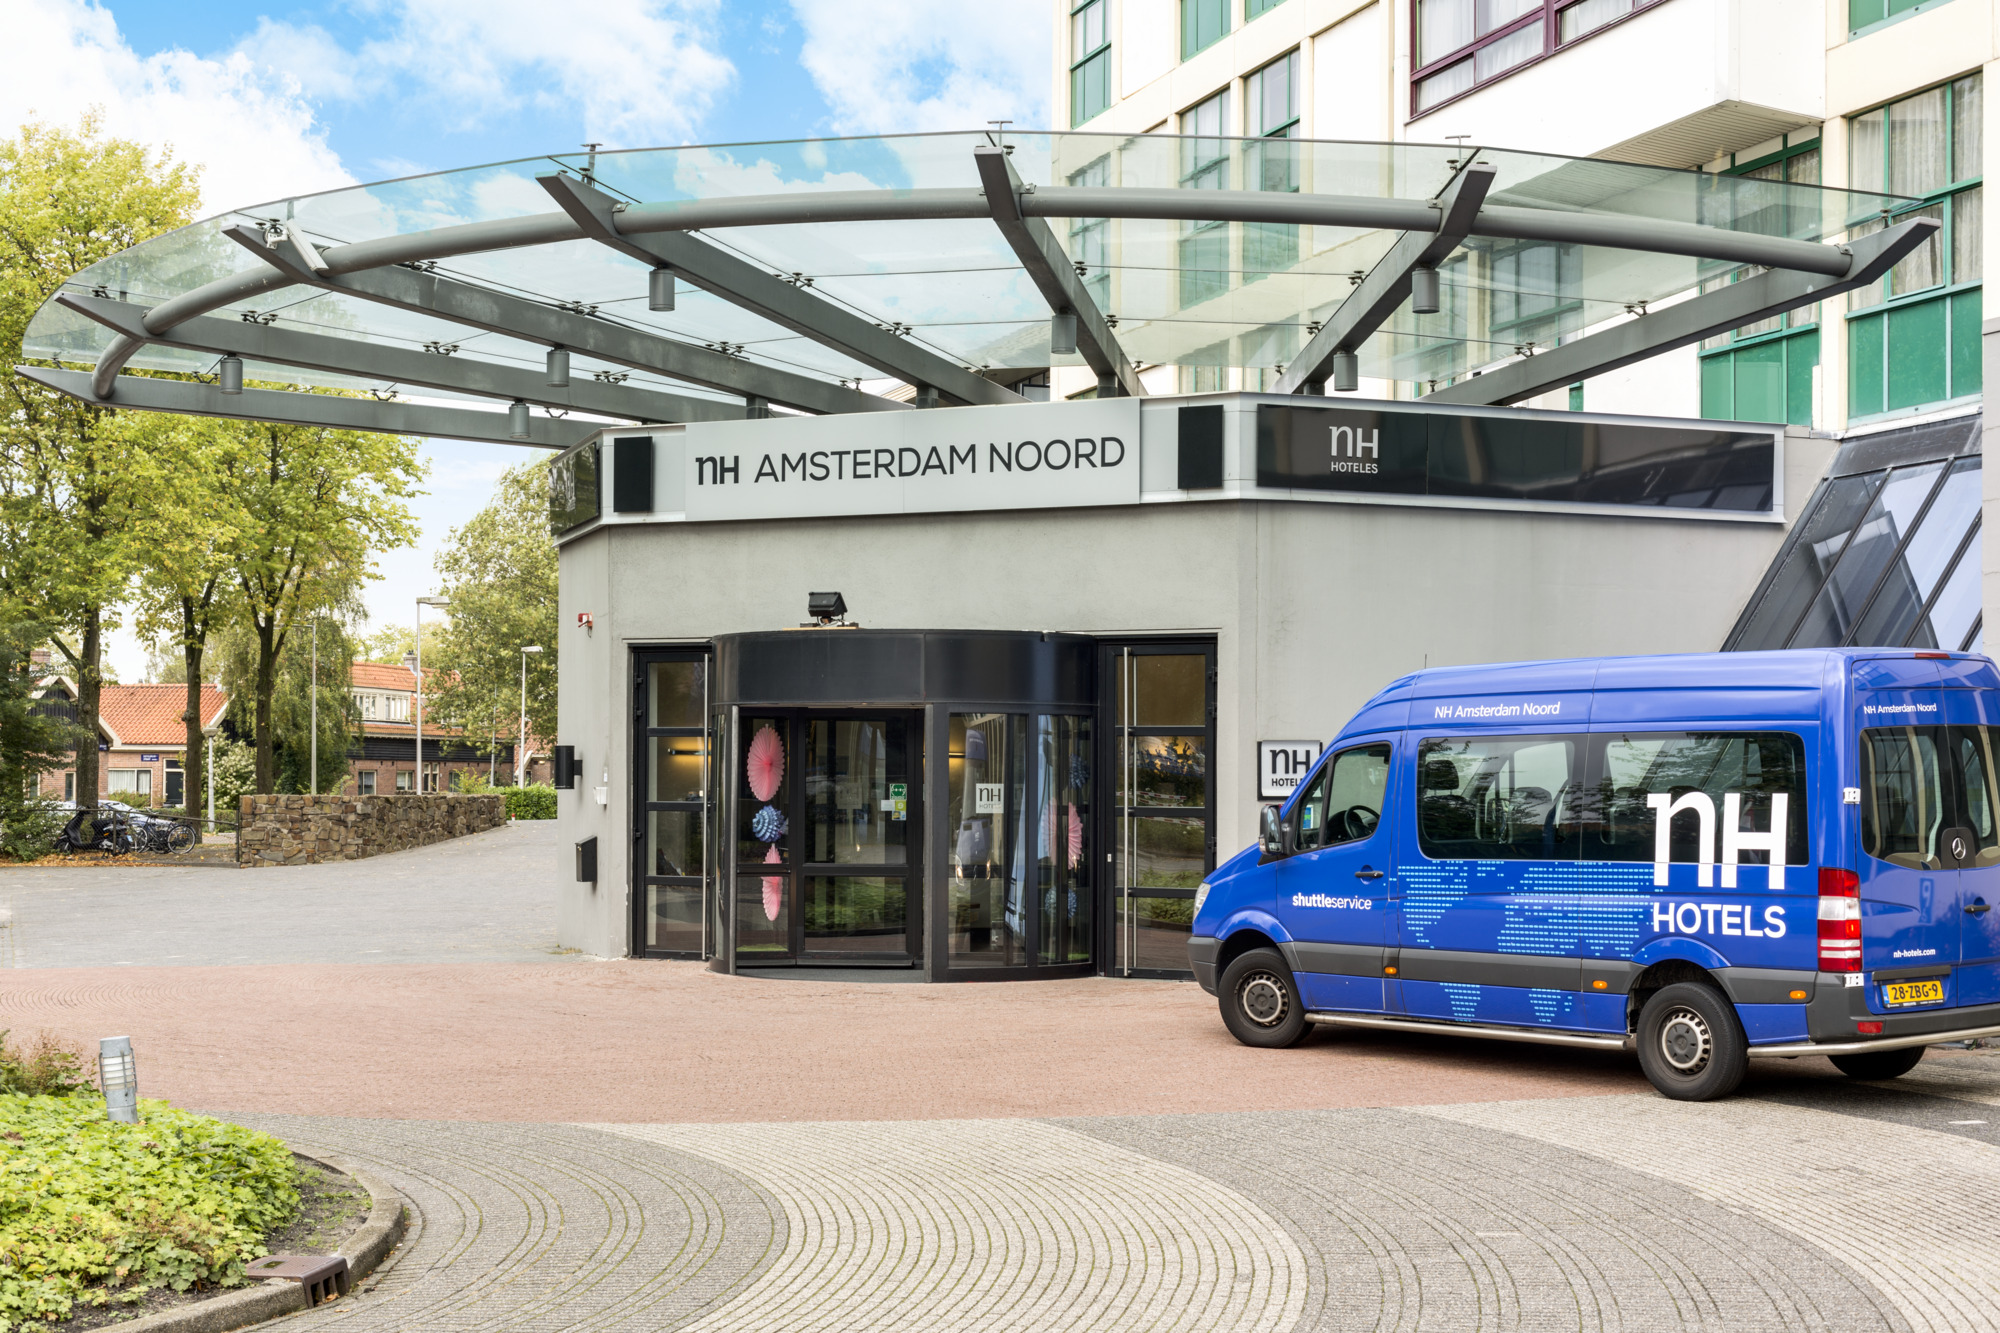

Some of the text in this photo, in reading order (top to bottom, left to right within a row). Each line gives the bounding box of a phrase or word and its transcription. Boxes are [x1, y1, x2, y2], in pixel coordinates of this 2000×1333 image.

[754, 444, 977, 484] AMSTERDAM
[989, 436, 1126, 473] NOORD
[1330, 461, 1379, 474] HOTELES
[1434, 701, 1561, 718] NH Amsterdam Noord
[1863, 702, 1937, 714] NH Amsterdam Noord
[1292, 892, 1372, 910] shuttleservice
[1653, 902, 1787, 939] HOTELS
[1893, 949, 1936, 958] nh-hotels.com
[1891, 983, 1938, 1000] 28-ZBG-9
